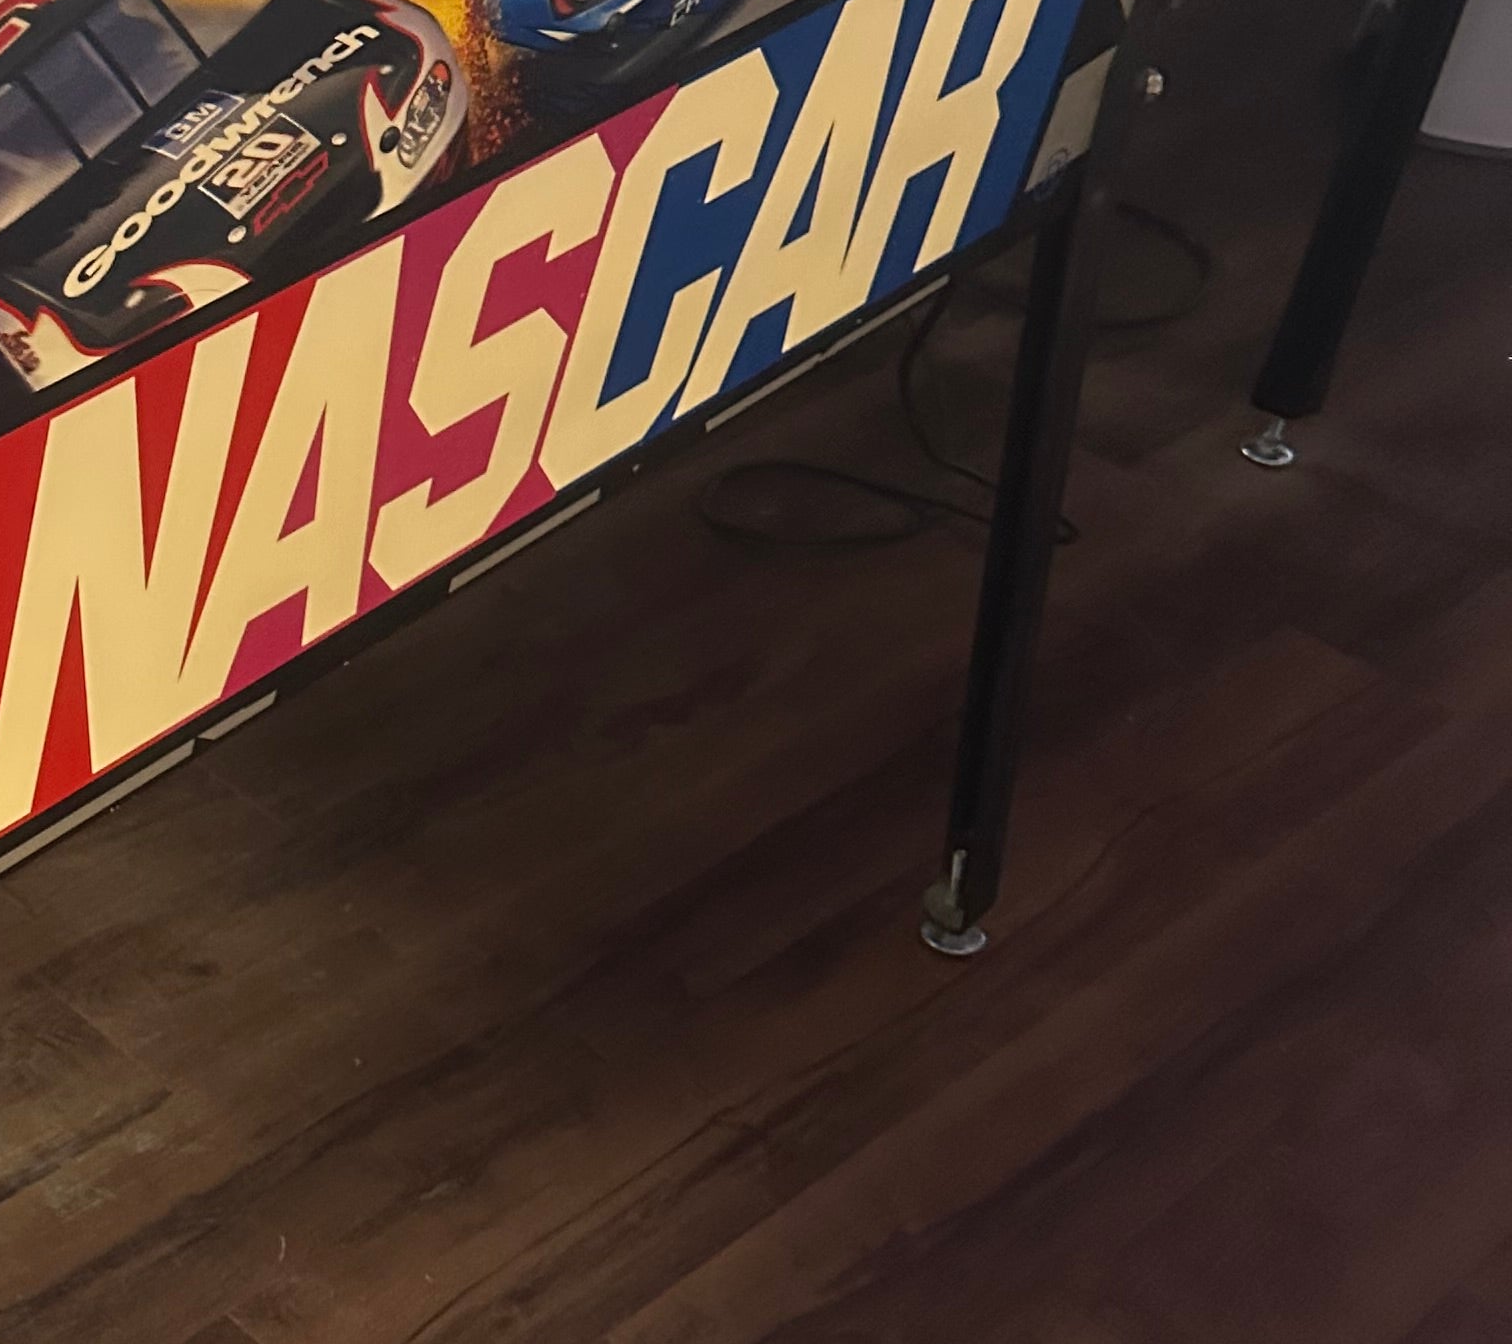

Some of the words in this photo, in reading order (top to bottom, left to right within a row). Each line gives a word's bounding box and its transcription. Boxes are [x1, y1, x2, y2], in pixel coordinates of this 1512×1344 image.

[164, 102, 218, 142] GM
[63, 24, 381, 298] Goodwrench
[213, 132, 294, 188] 20
